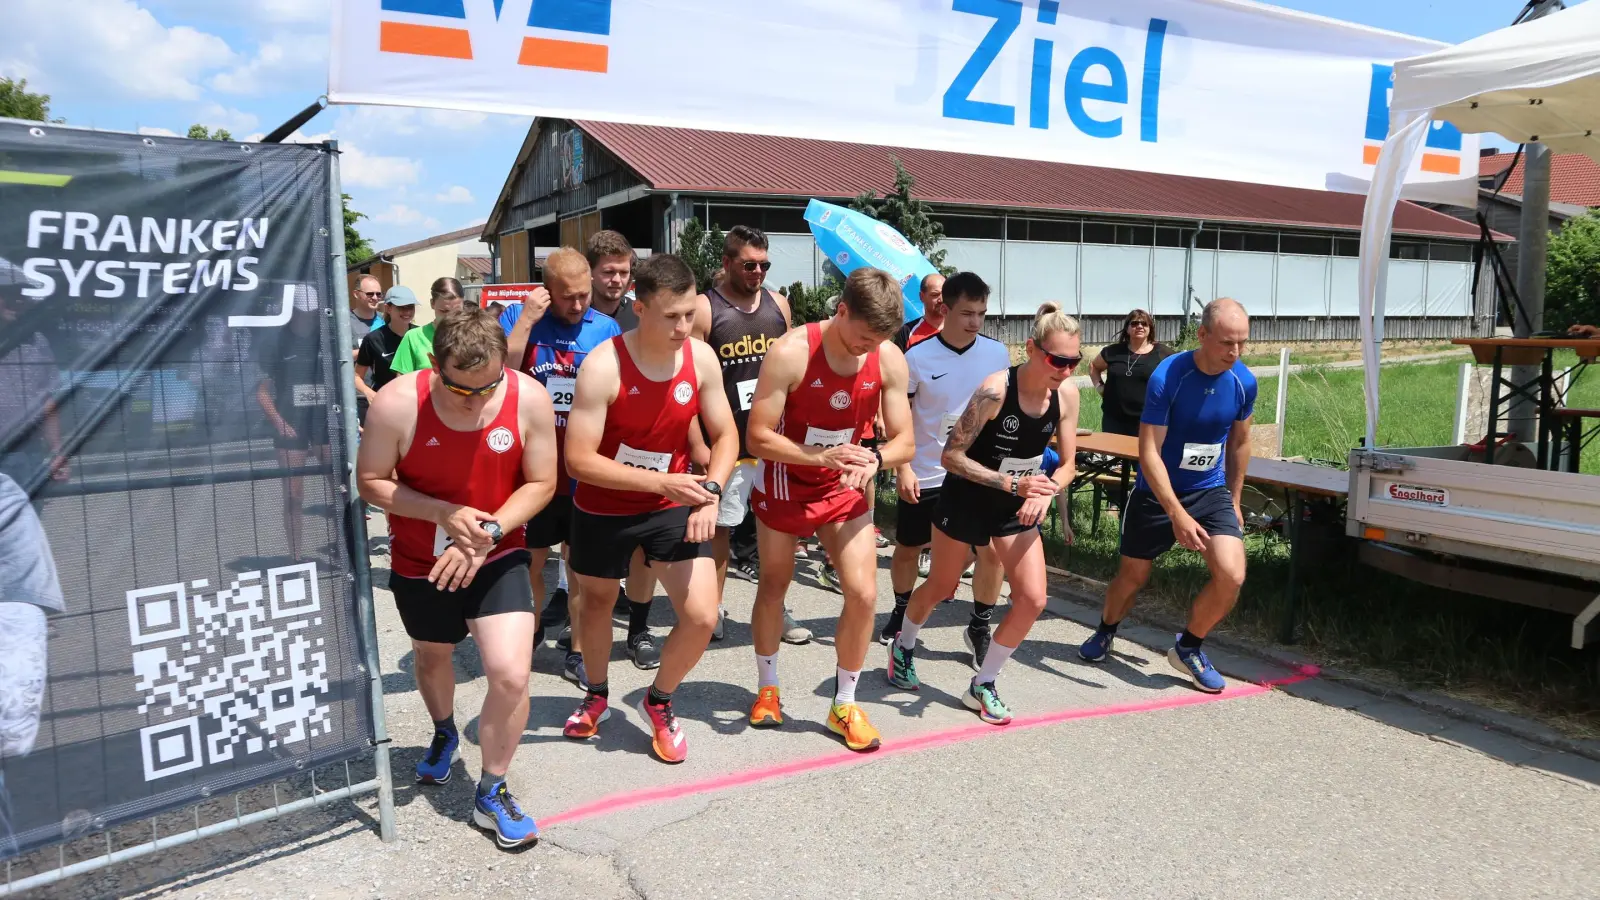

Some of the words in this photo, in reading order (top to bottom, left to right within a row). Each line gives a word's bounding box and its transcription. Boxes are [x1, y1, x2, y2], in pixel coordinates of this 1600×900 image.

[943, 0, 1168, 142] Ziel
[27, 209, 268, 254] FRANKEN
[21, 256, 259, 298] SYSTEMS
[492, 431, 510, 447] TVO
[1187, 455, 1215, 466] 267
[1389, 484, 1445, 502] Engelhard
